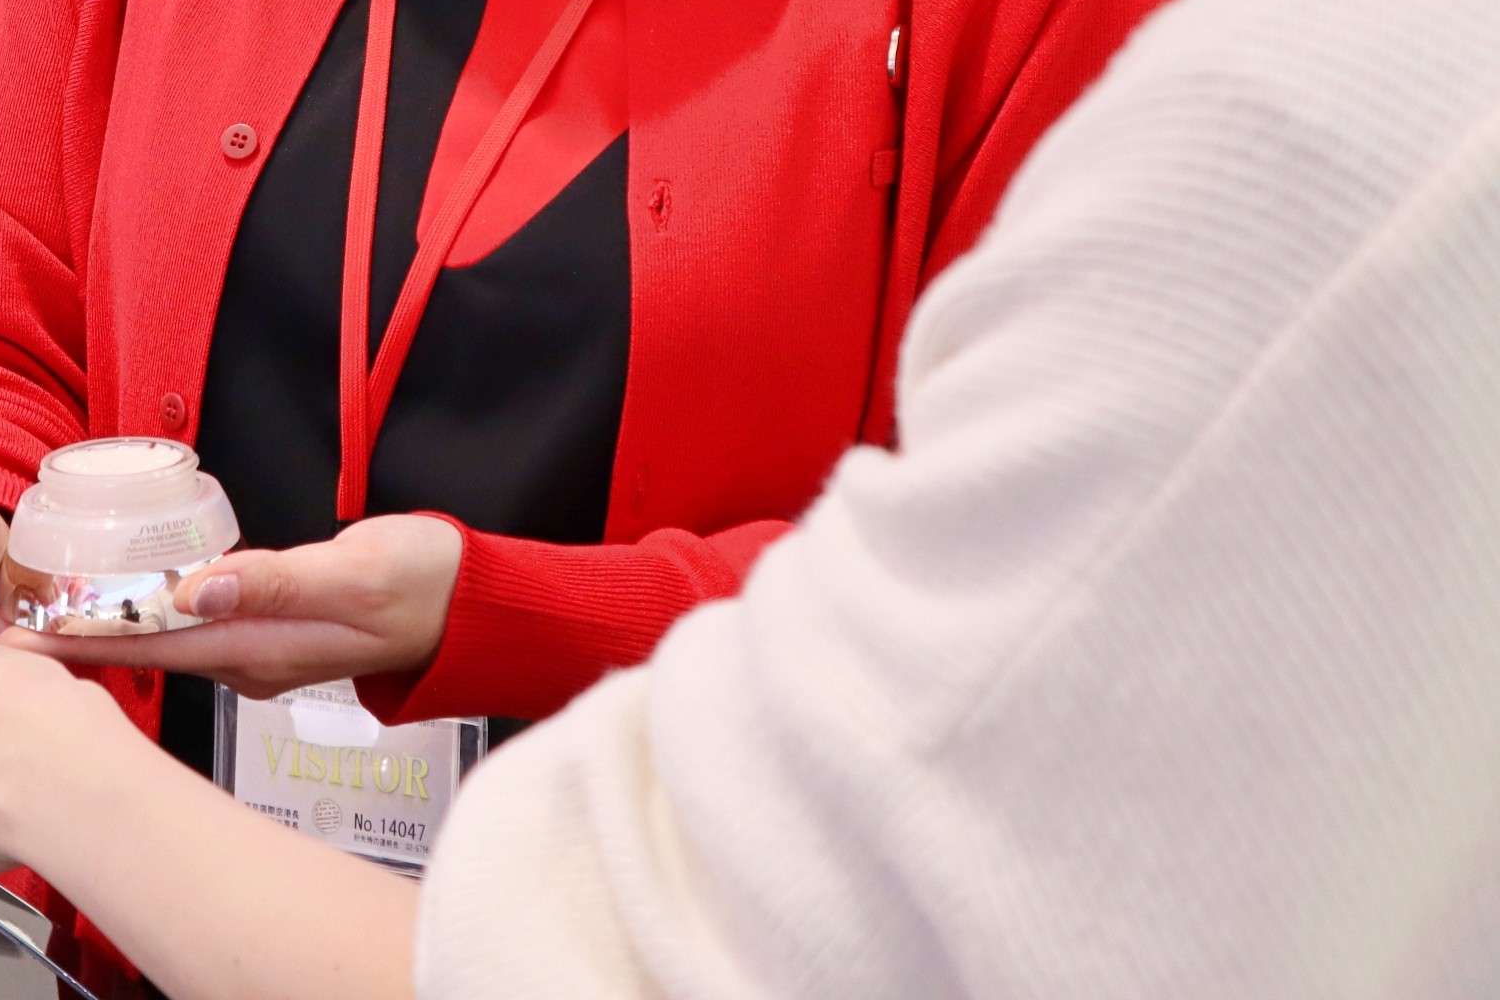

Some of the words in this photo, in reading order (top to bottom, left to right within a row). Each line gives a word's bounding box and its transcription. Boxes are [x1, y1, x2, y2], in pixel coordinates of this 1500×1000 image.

[137, 519, 191, 537] SHISEIDO
[260, 732, 430, 800] VISITOR
[354, 812, 426, 842] No.14047
